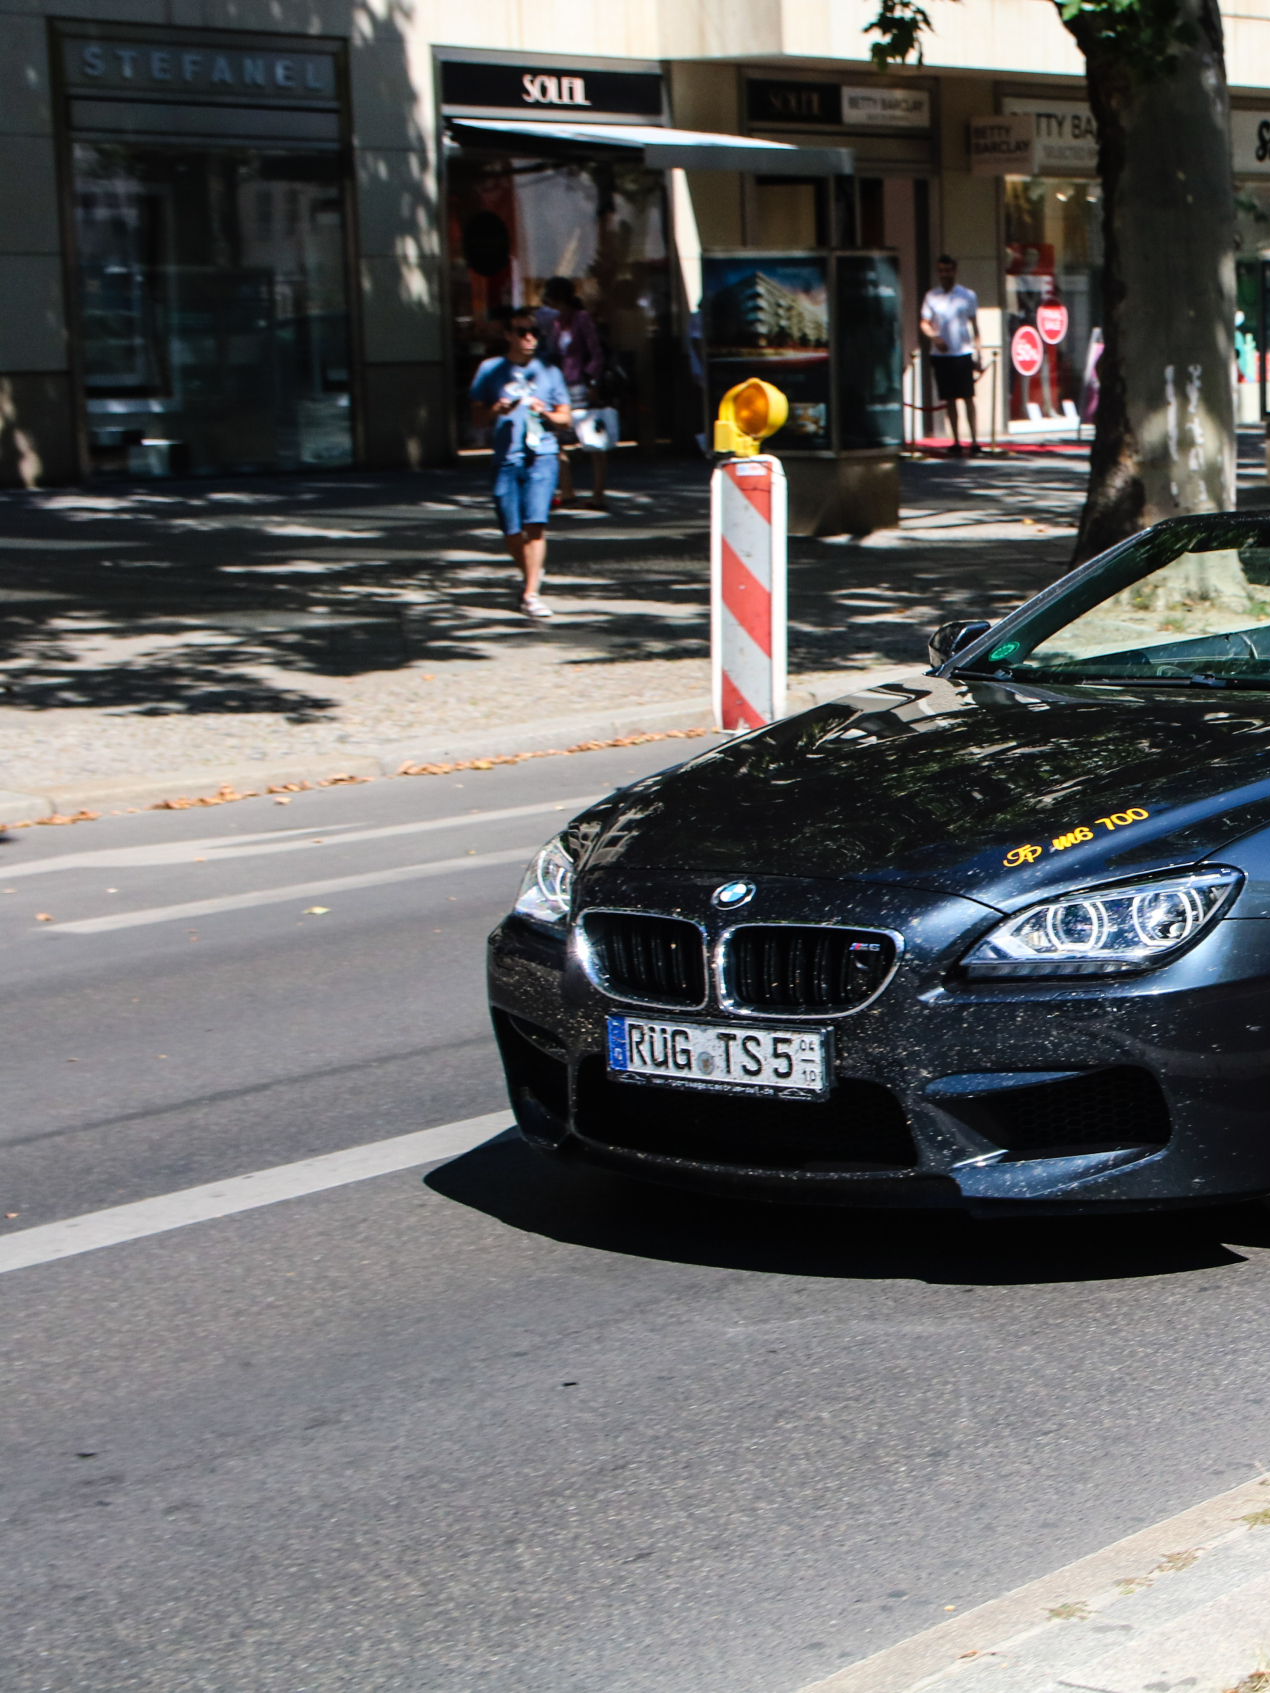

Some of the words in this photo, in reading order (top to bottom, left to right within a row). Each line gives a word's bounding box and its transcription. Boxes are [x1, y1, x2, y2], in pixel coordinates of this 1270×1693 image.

[82, 46, 325, 92] STEFANEL
[521, 73, 592, 106] SOLEIL
[1094, 807, 1150, 831] 700
[627, 1022, 693, 1071] RÜG
